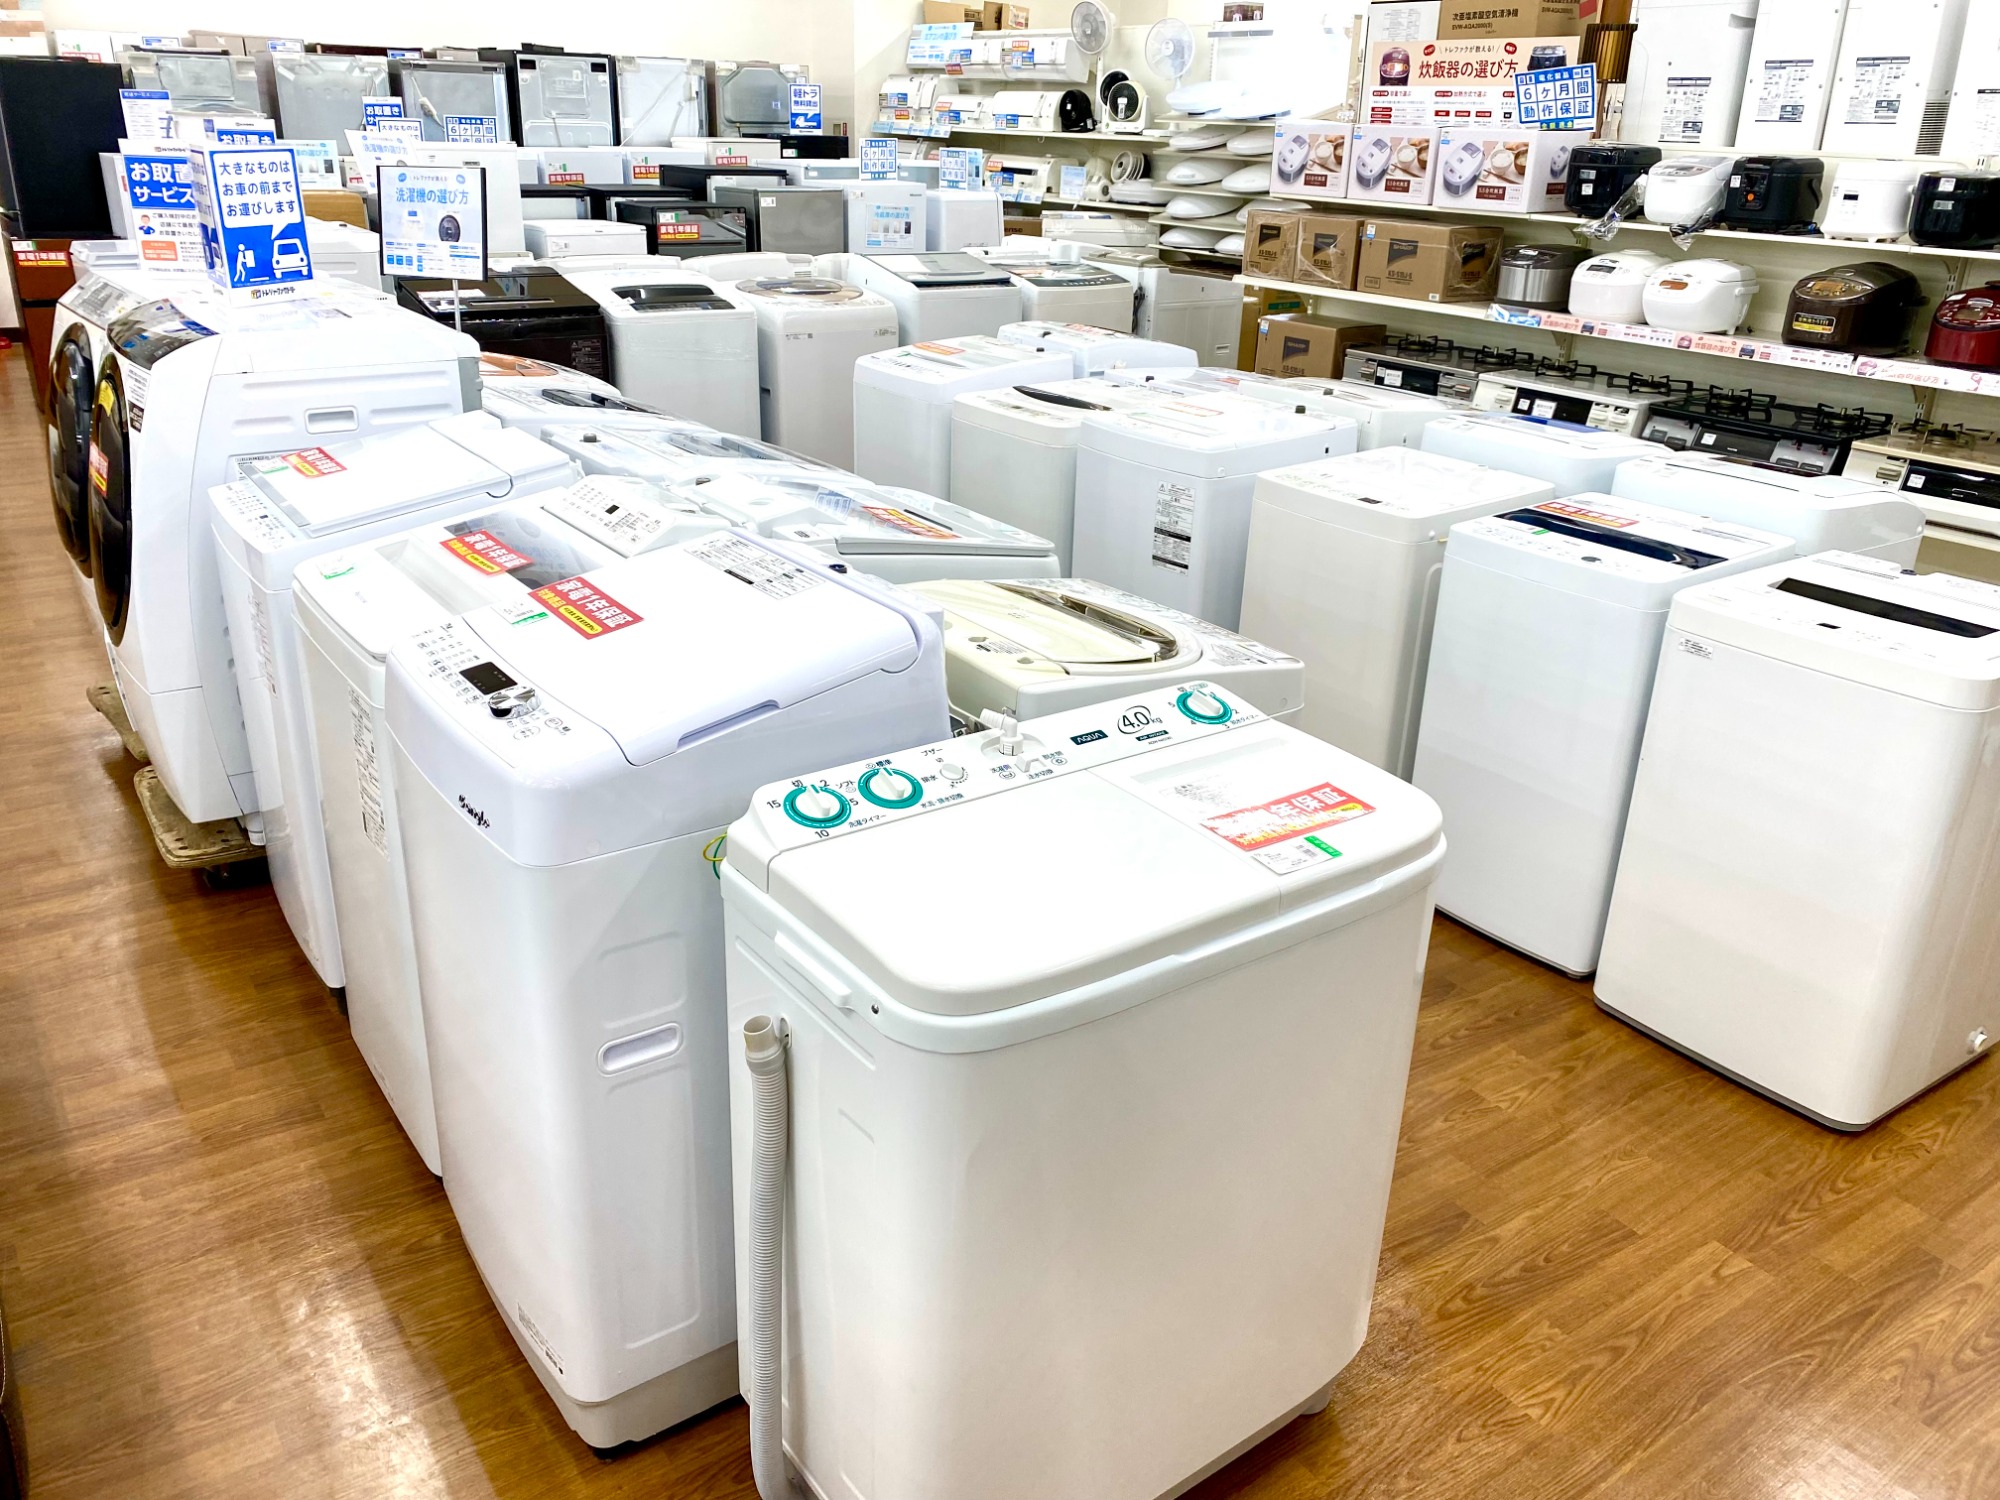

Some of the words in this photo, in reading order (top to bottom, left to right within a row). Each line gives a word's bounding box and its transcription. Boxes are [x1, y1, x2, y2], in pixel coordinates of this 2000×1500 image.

[1452, 8, 1519, 21] 次亜塩素酸空気清浄機
[1418, 59, 1519, 79] 炊飯器の選び方
[793, 88, 818, 98] 軽トラ
[365, 105, 400, 116] お取置き
[1523, 100, 1590, 119] 動作保証
[381, 124, 419, 132] 大きなものは
[219, 161, 291, 176] 大きなものは
[863, 161, 894, 170] 動作保証
[222, 183, 293, 197] お車の前まで
[396, 187, 469, 205] 洗濯機の選び方
[226, 199, 296, 216] お運びします
[660, 225, 699, 234] 家電1年保証
[463, 532, 530, 568] 家電1年保証
[555, 580, 635, 628] 家電1年保証
[1076, 732, 1103, 743] AQUA
[920, 748, 943, 757] ブザー
[875, 759, 892, 768] 標準
[792, 779, 803, 788] 切
[819, 779, 829, 788] 2
[835, 780, 856, 790] ソフト
[766, 799, 782, 810] 15
[850, 798, 859, 806] 5
[814, 829, 829, 839] 10
